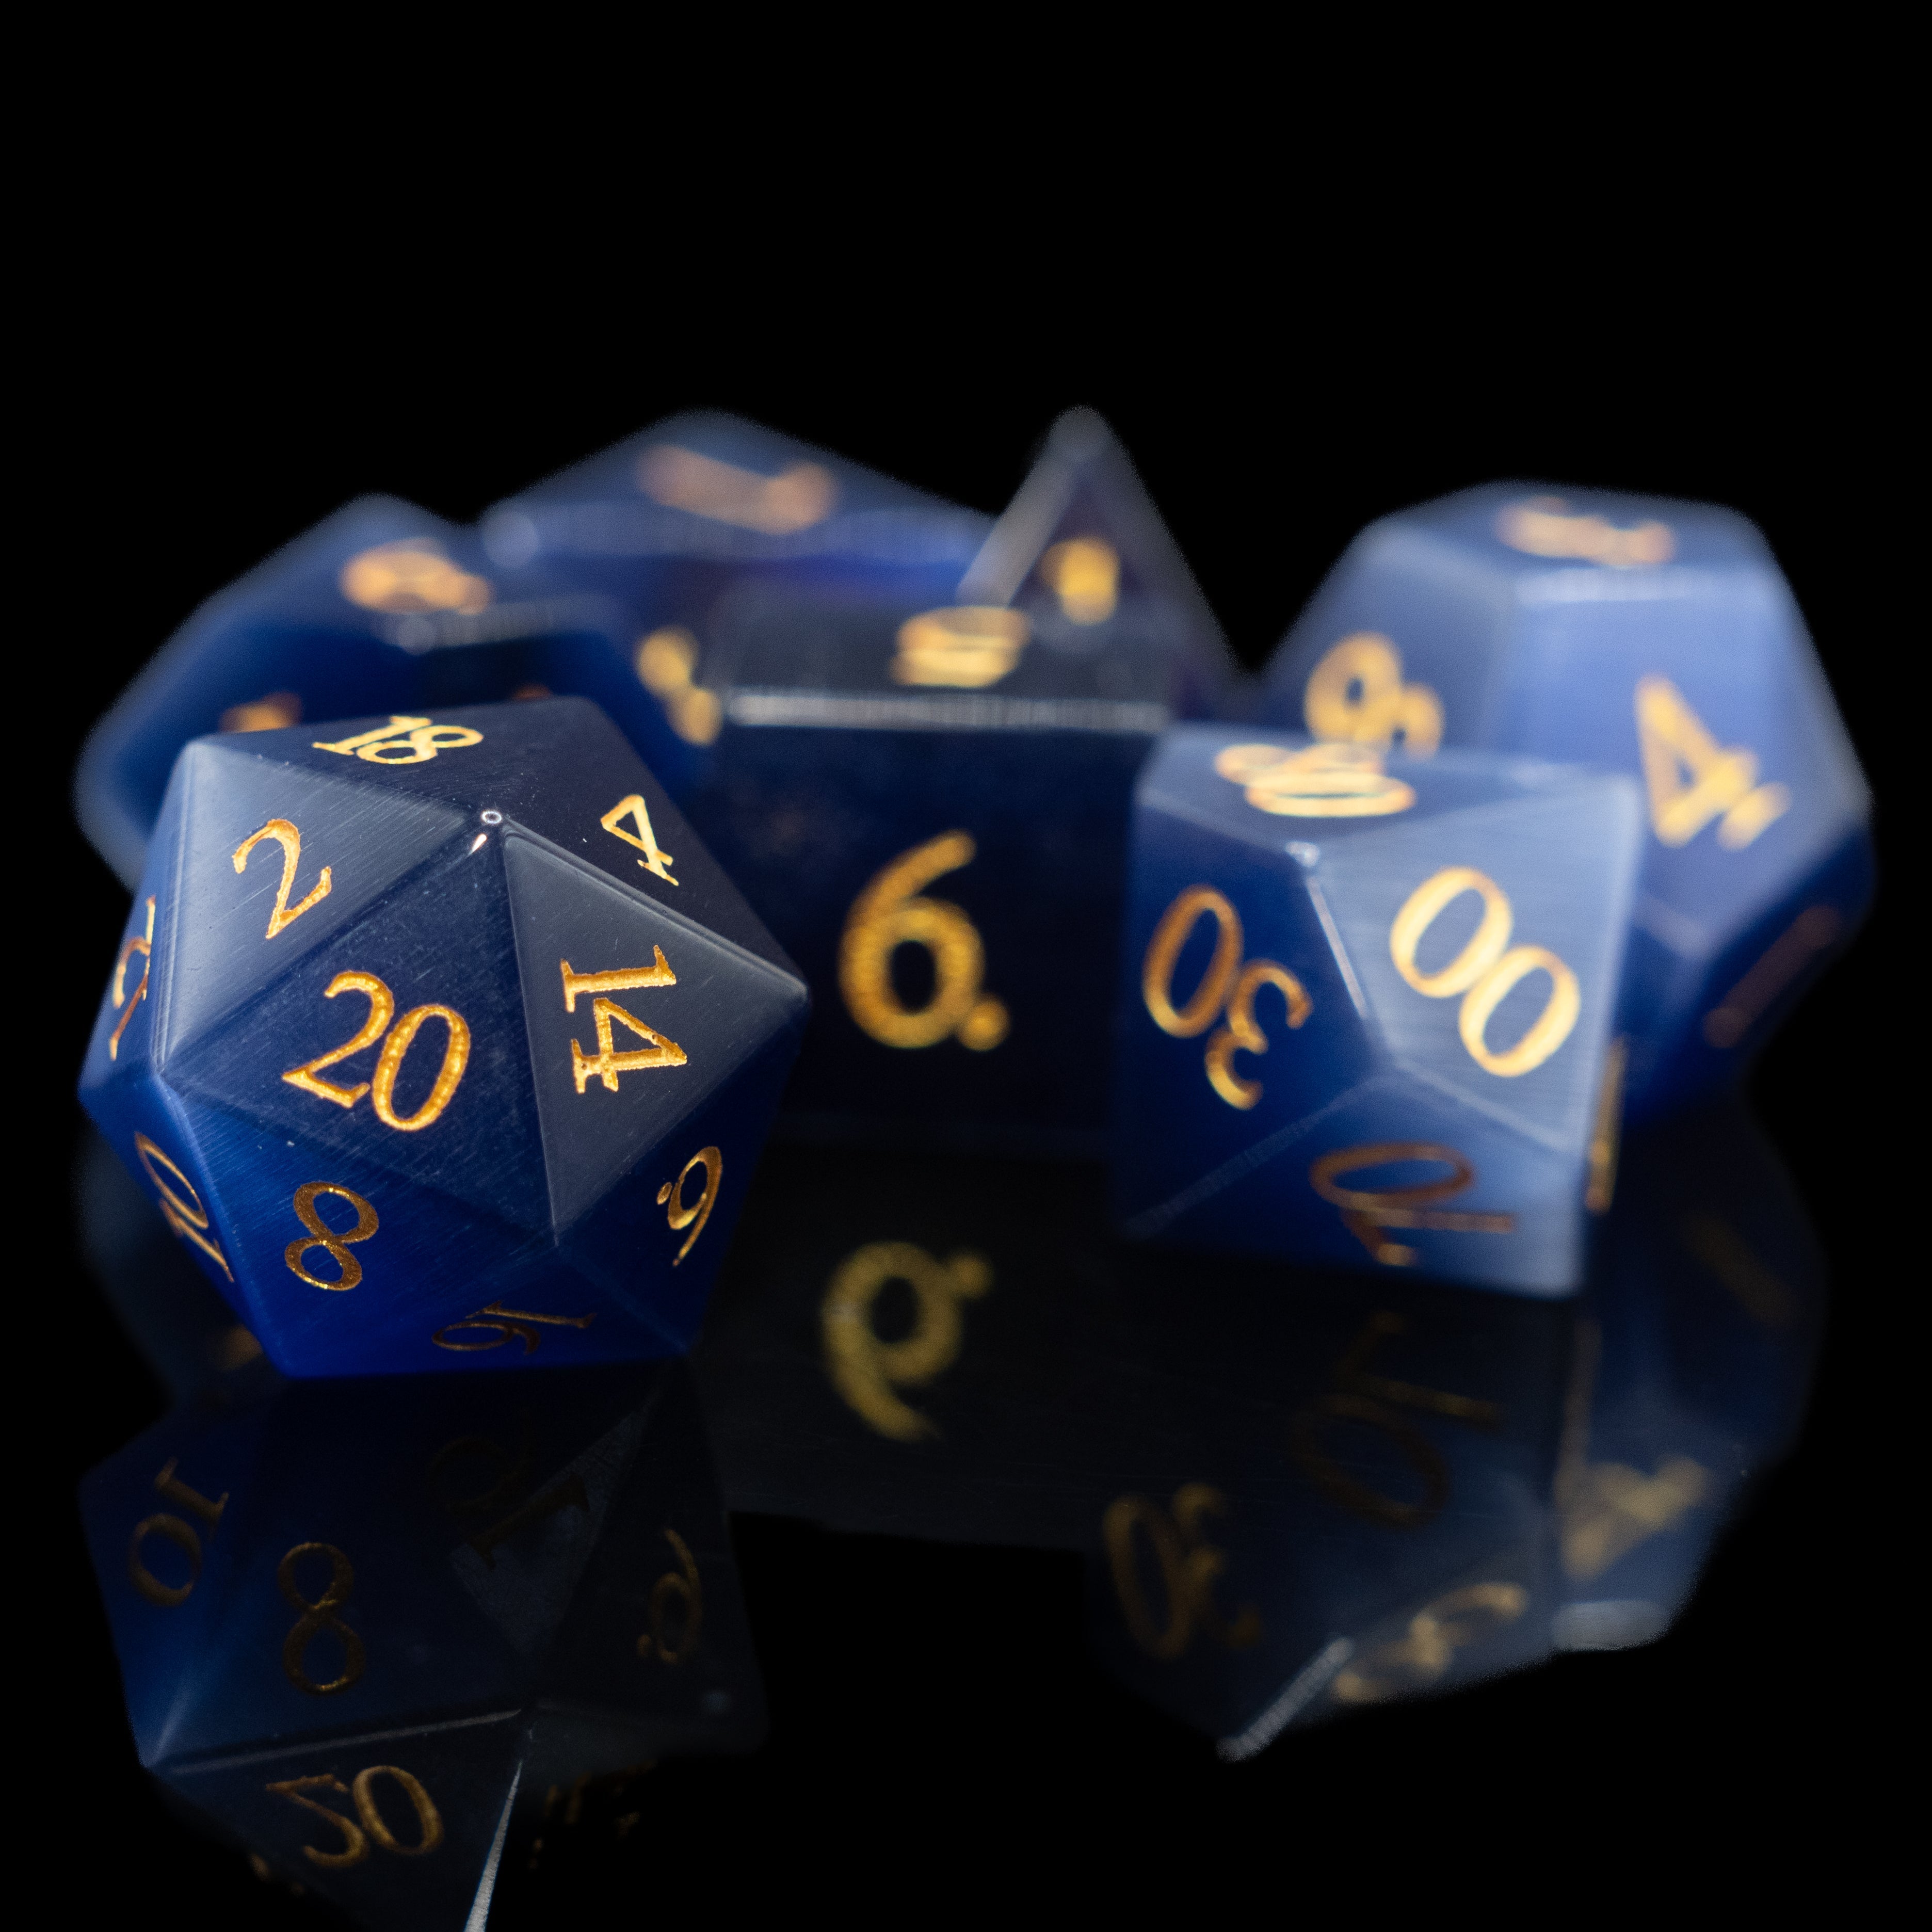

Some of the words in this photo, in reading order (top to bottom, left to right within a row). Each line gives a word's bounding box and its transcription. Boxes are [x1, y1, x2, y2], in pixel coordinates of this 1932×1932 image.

[313, 715, 484, 765] 18
[232, 818, 332, 939] 2
[600, 794, 679, 886] 4
[560, 945, 688, 1094] 14
[1141, 884, 1313, 1110] 30
[1389, 865, 1581, 1078] 00
[282, 970, 472, 1132] 20
[134, 1131, 235, 1283] 10
[284, 1181, 380, 1292] 8
